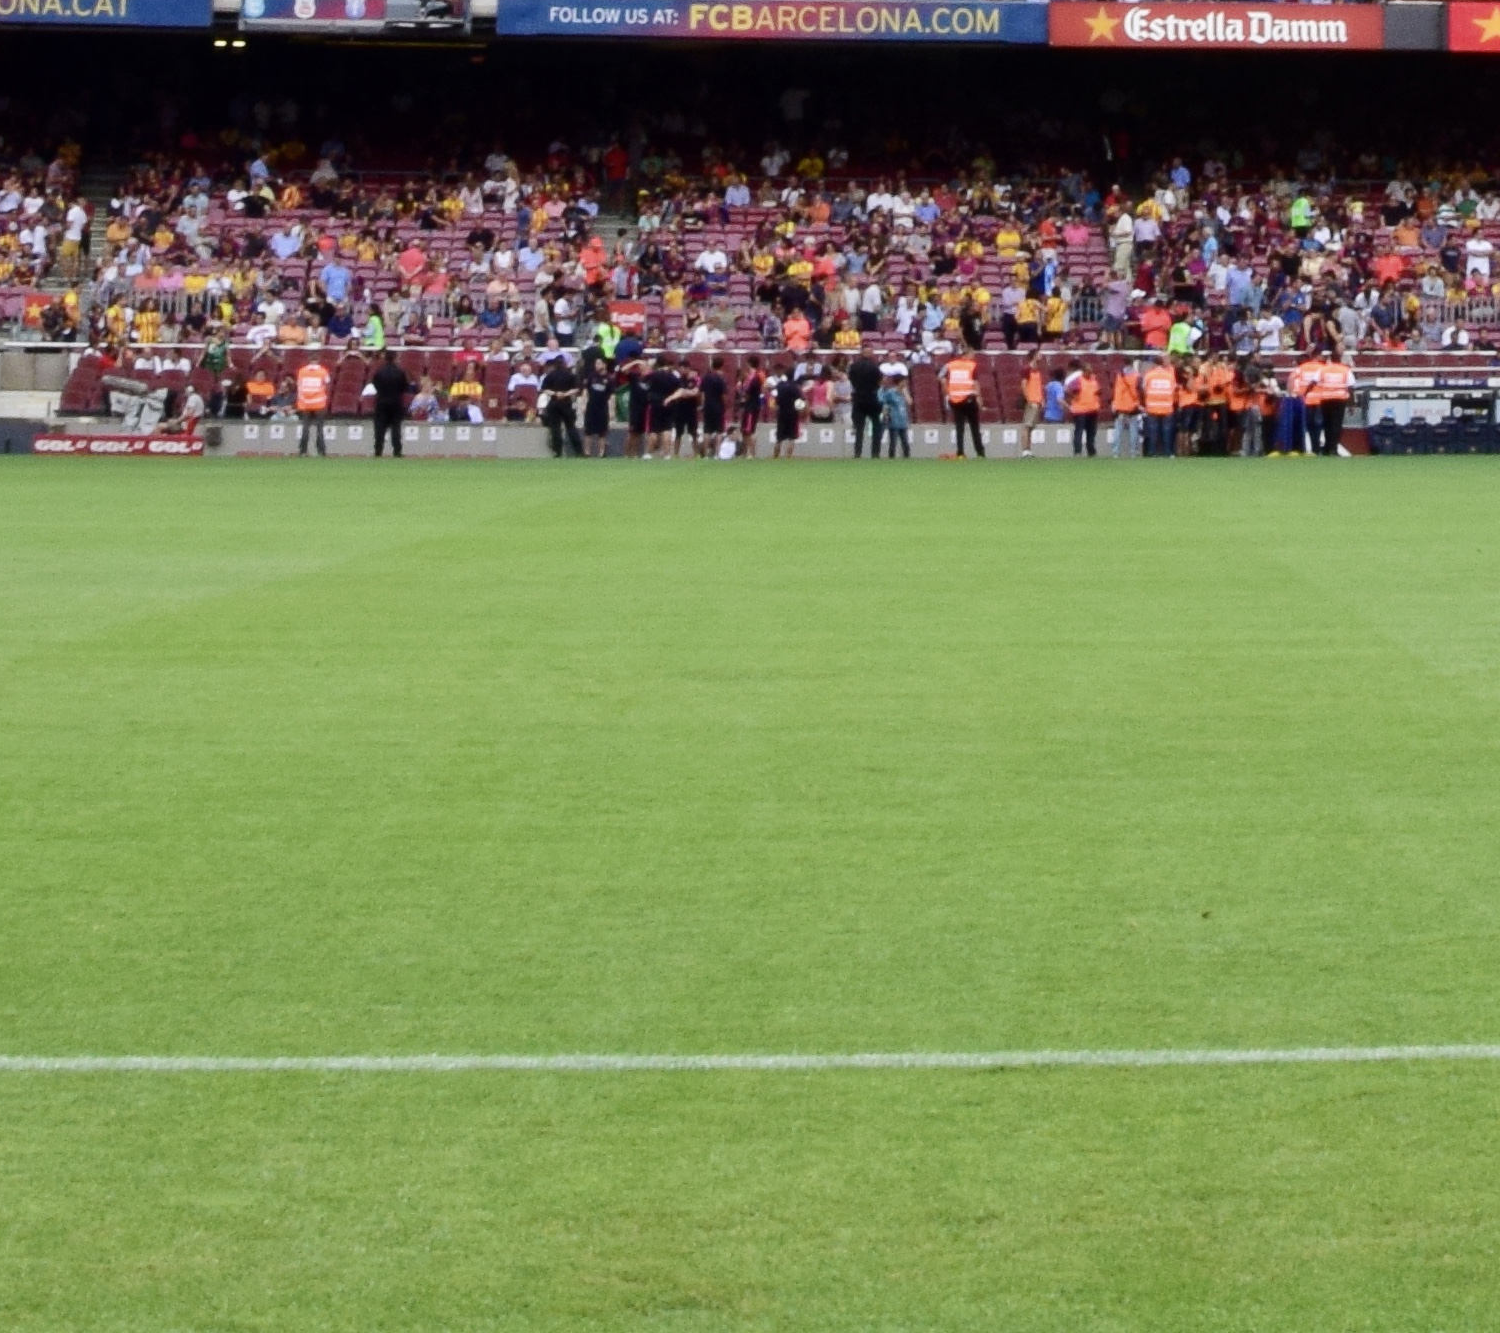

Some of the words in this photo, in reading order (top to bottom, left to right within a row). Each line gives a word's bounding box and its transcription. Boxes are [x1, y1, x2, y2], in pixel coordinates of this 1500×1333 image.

[549, 6, 621, 25] FOLLOW
[624, 8, 649, 25] US
[653, 10, 679, 26] AT:
[689, 3, 1000, 34] FCBARCELONA.COM
[1124, 6, 1245, 42] Estrella
[1246, 10, 1348, 44] Damm
